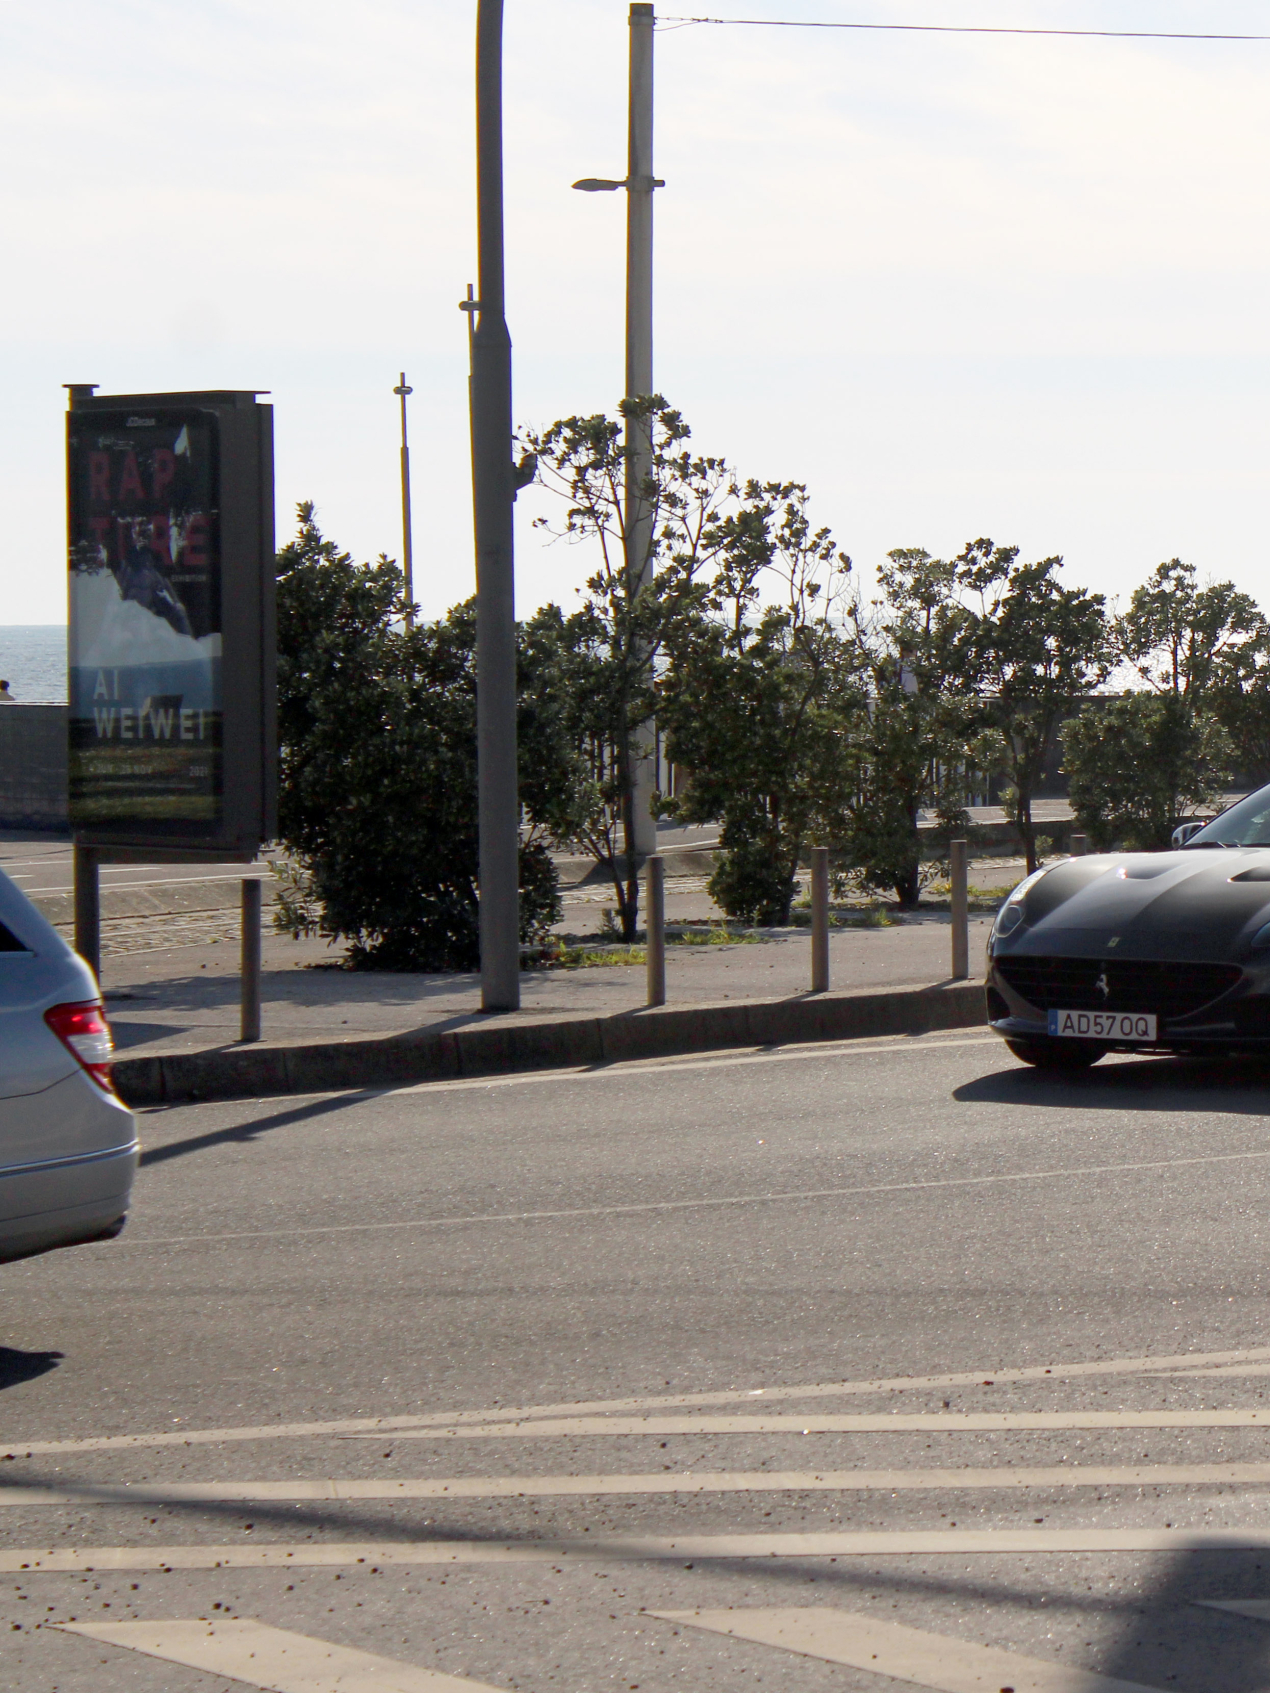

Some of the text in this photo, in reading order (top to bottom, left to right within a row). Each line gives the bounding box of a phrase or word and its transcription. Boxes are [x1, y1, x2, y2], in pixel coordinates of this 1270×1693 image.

[88, 449, 176, 501] RAP
[93, 669, 119, 700] AI
[93, 707, 205, 740] WEIWEI
